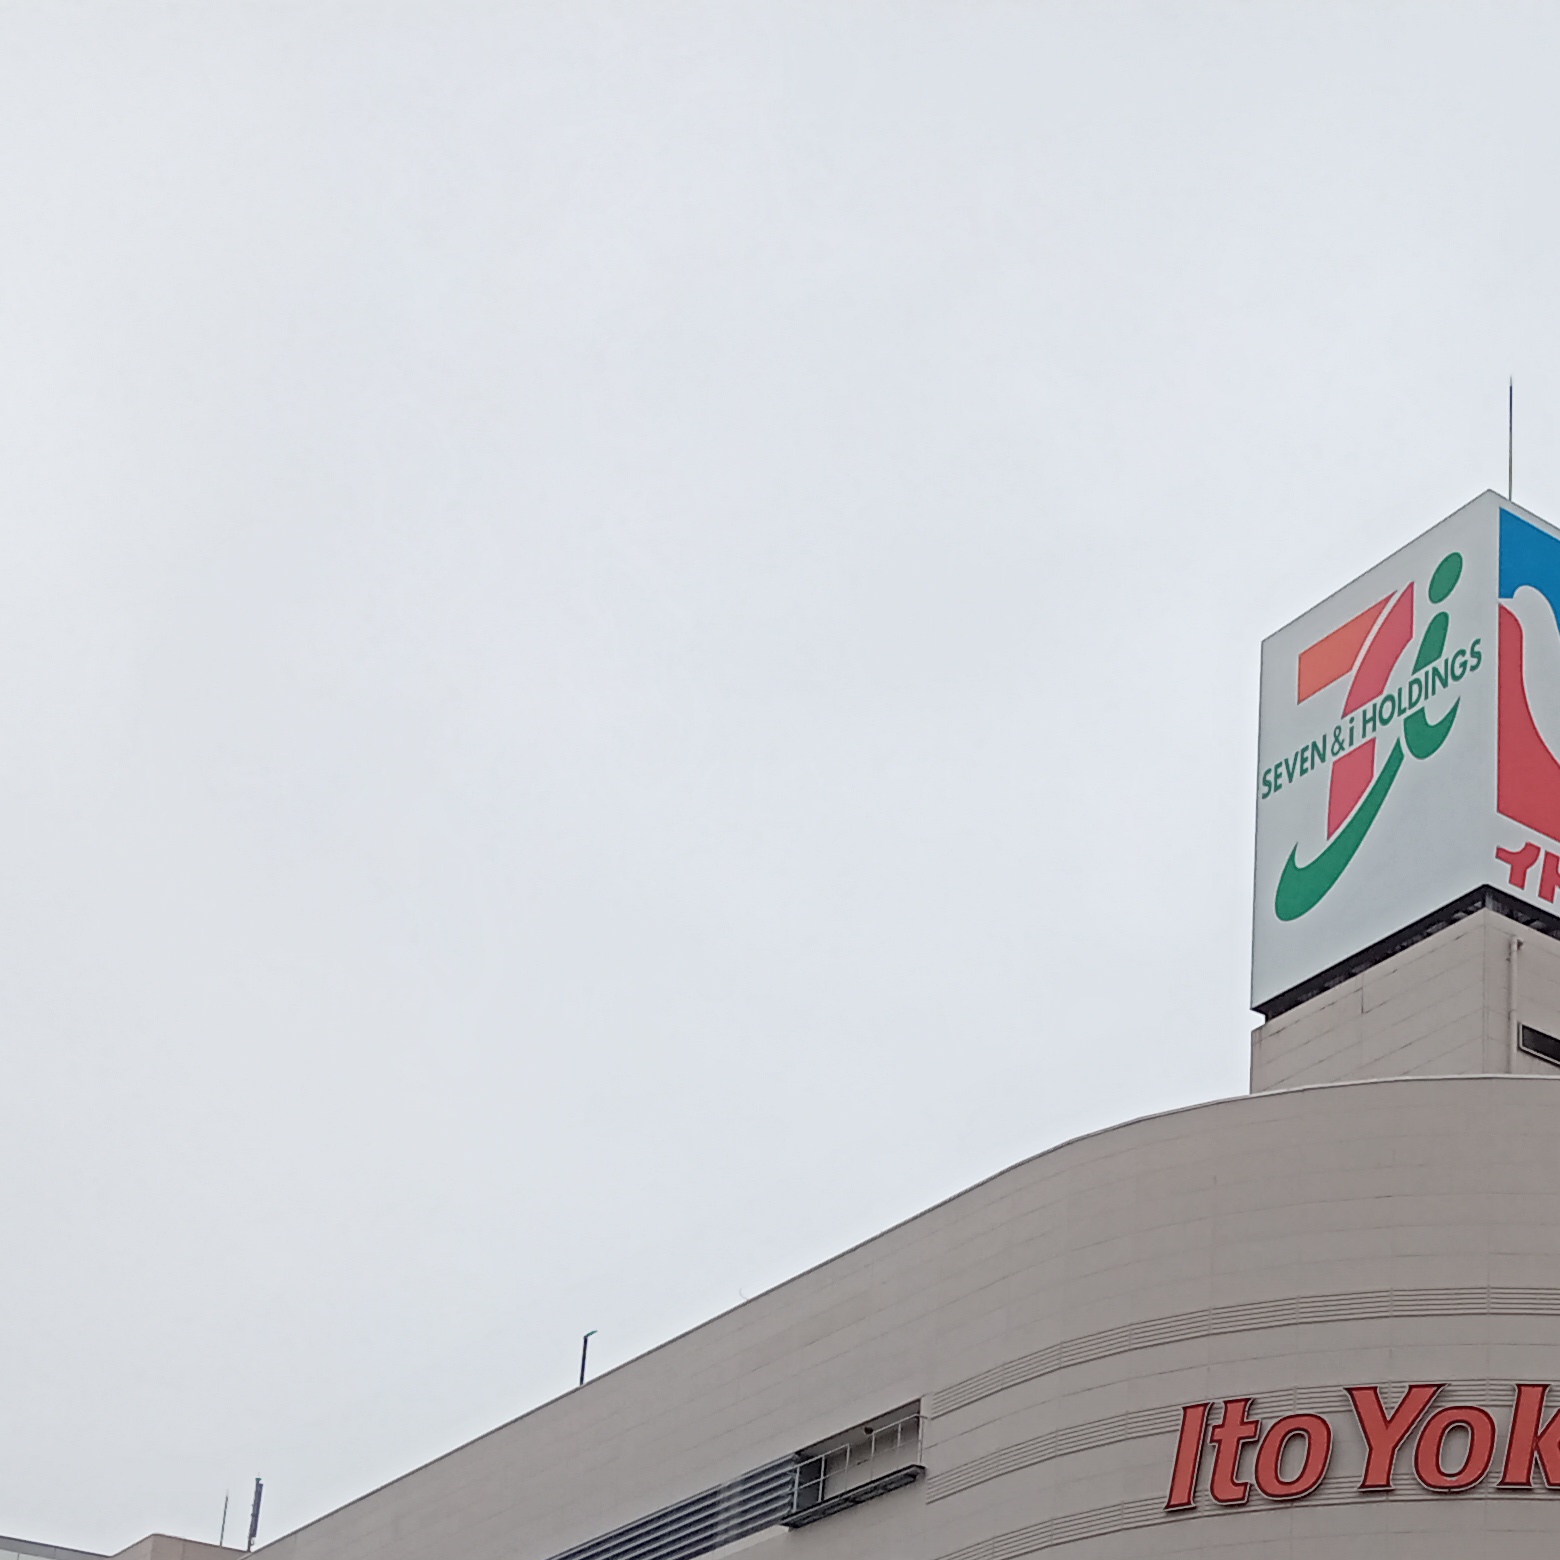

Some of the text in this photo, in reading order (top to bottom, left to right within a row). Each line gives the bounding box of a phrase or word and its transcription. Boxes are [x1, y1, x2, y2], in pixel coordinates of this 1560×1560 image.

[1261, 734, 1328, 800] SEVEN
[1330, 724, 1346, 755] &
[1361, 638, 1483, 738] HOLDINGS
[1164, 1396, 1332, 1512] Ito
